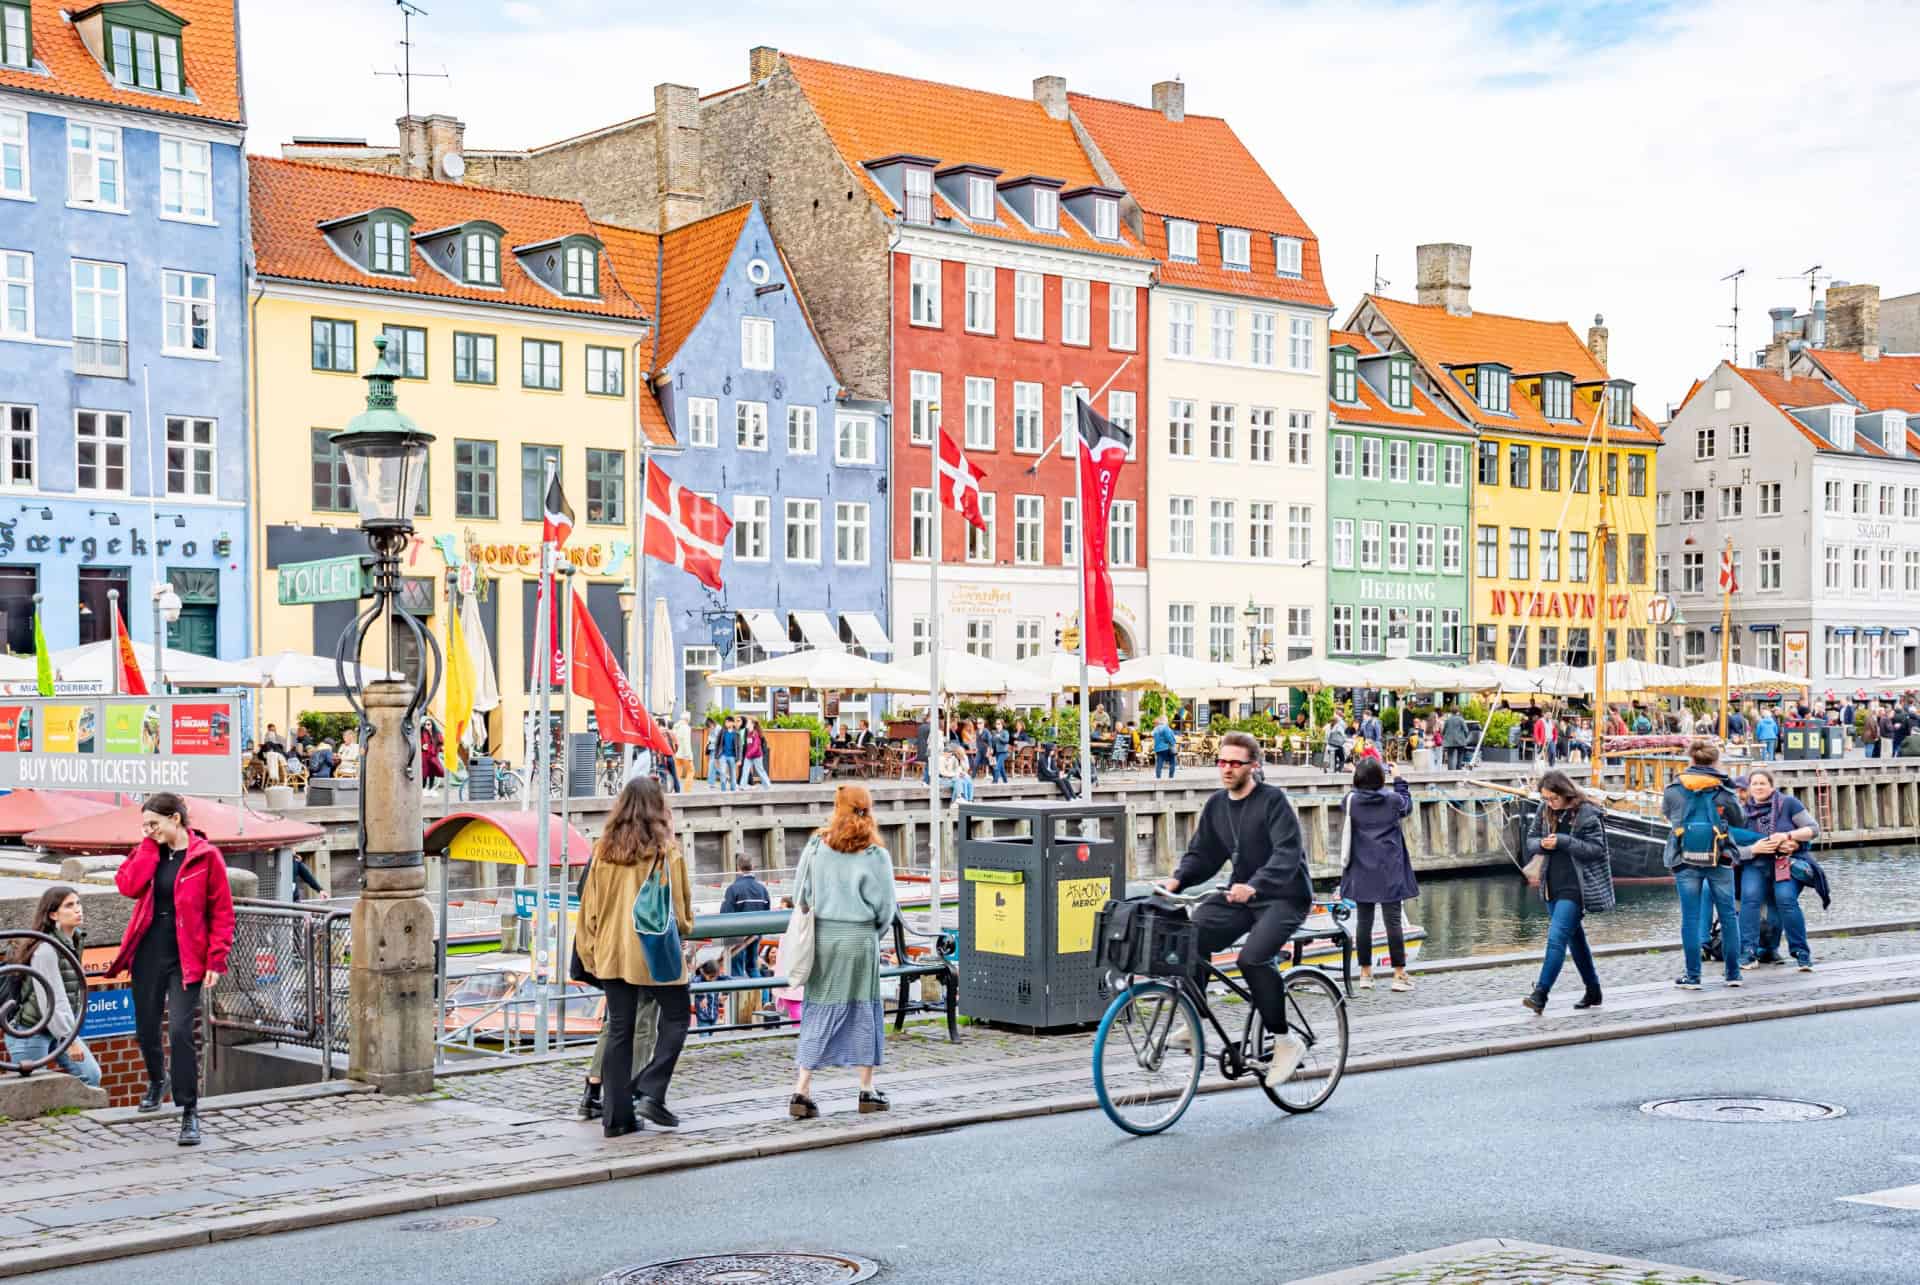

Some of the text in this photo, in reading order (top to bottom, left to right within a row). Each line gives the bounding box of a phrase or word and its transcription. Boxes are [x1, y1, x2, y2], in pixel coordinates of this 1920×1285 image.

[282, 564, 355, 597] TOILET
[1361, 579, 1436, 600] HEERING
[1491, 589, 1631, 620] NYHAVN 17
[1648, 599, 1669, 622] 17
[20, 758, 189, 785] BUY YOUR TICKETS HERE
[1072, 898, 1097, 908] MERCI
